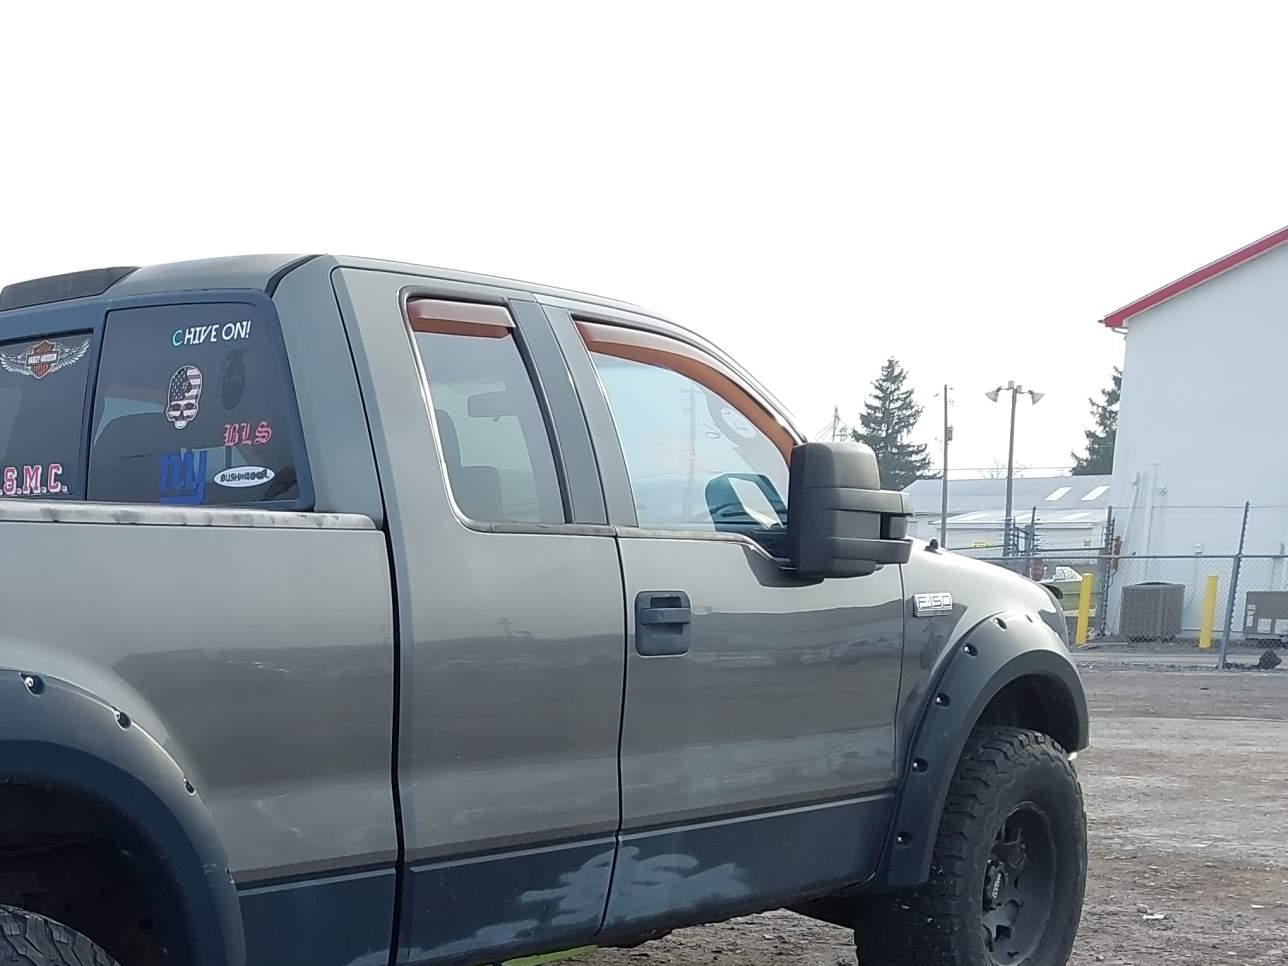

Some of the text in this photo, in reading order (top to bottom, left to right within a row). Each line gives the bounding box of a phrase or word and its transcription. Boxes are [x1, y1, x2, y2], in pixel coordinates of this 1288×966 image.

[172, 320, 251, 346] CHIVE ON!
[223, 421, 272, 447] BLS
